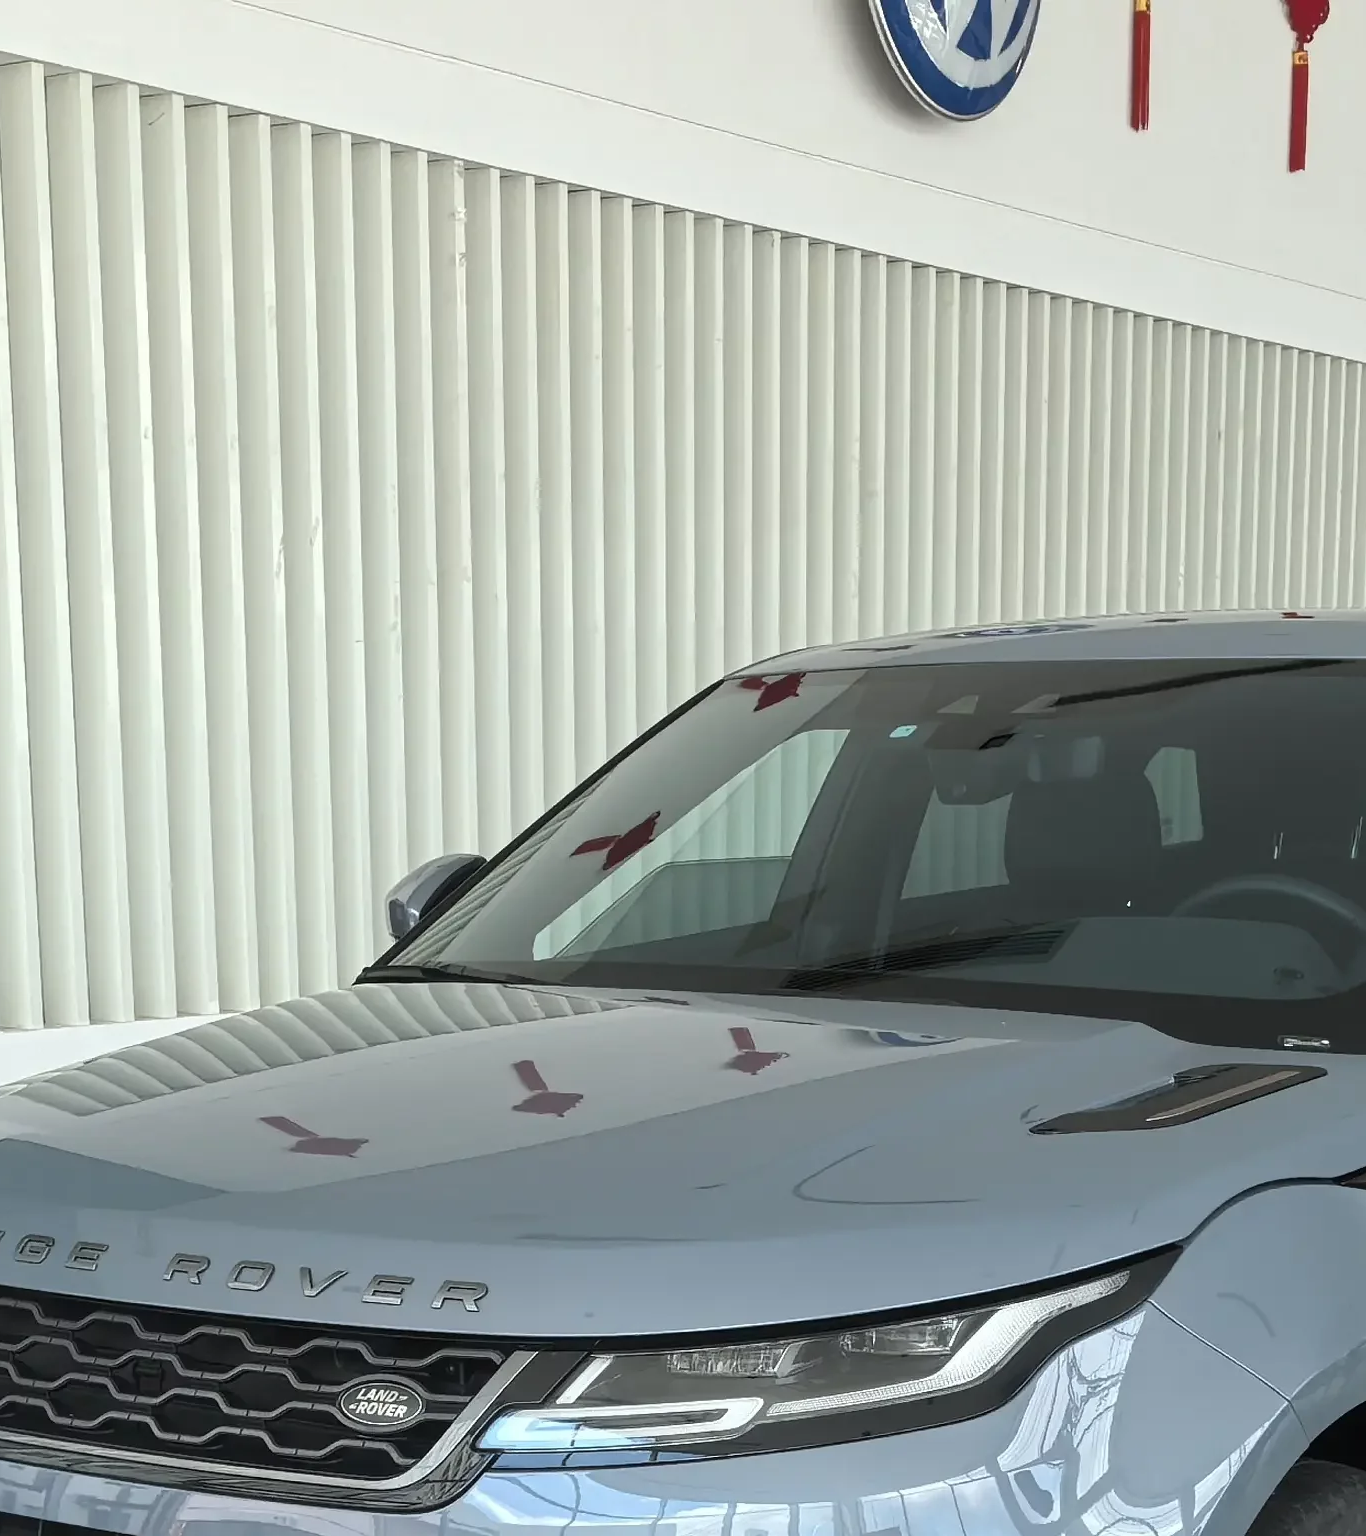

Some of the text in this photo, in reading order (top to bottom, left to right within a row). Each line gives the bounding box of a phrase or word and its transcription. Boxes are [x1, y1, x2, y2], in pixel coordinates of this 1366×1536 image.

[162, 1252, 490, 1313] ROVER
[356, 1388, 399, 1402] LAND
[355, 1401, 408, 1418] ROVER
